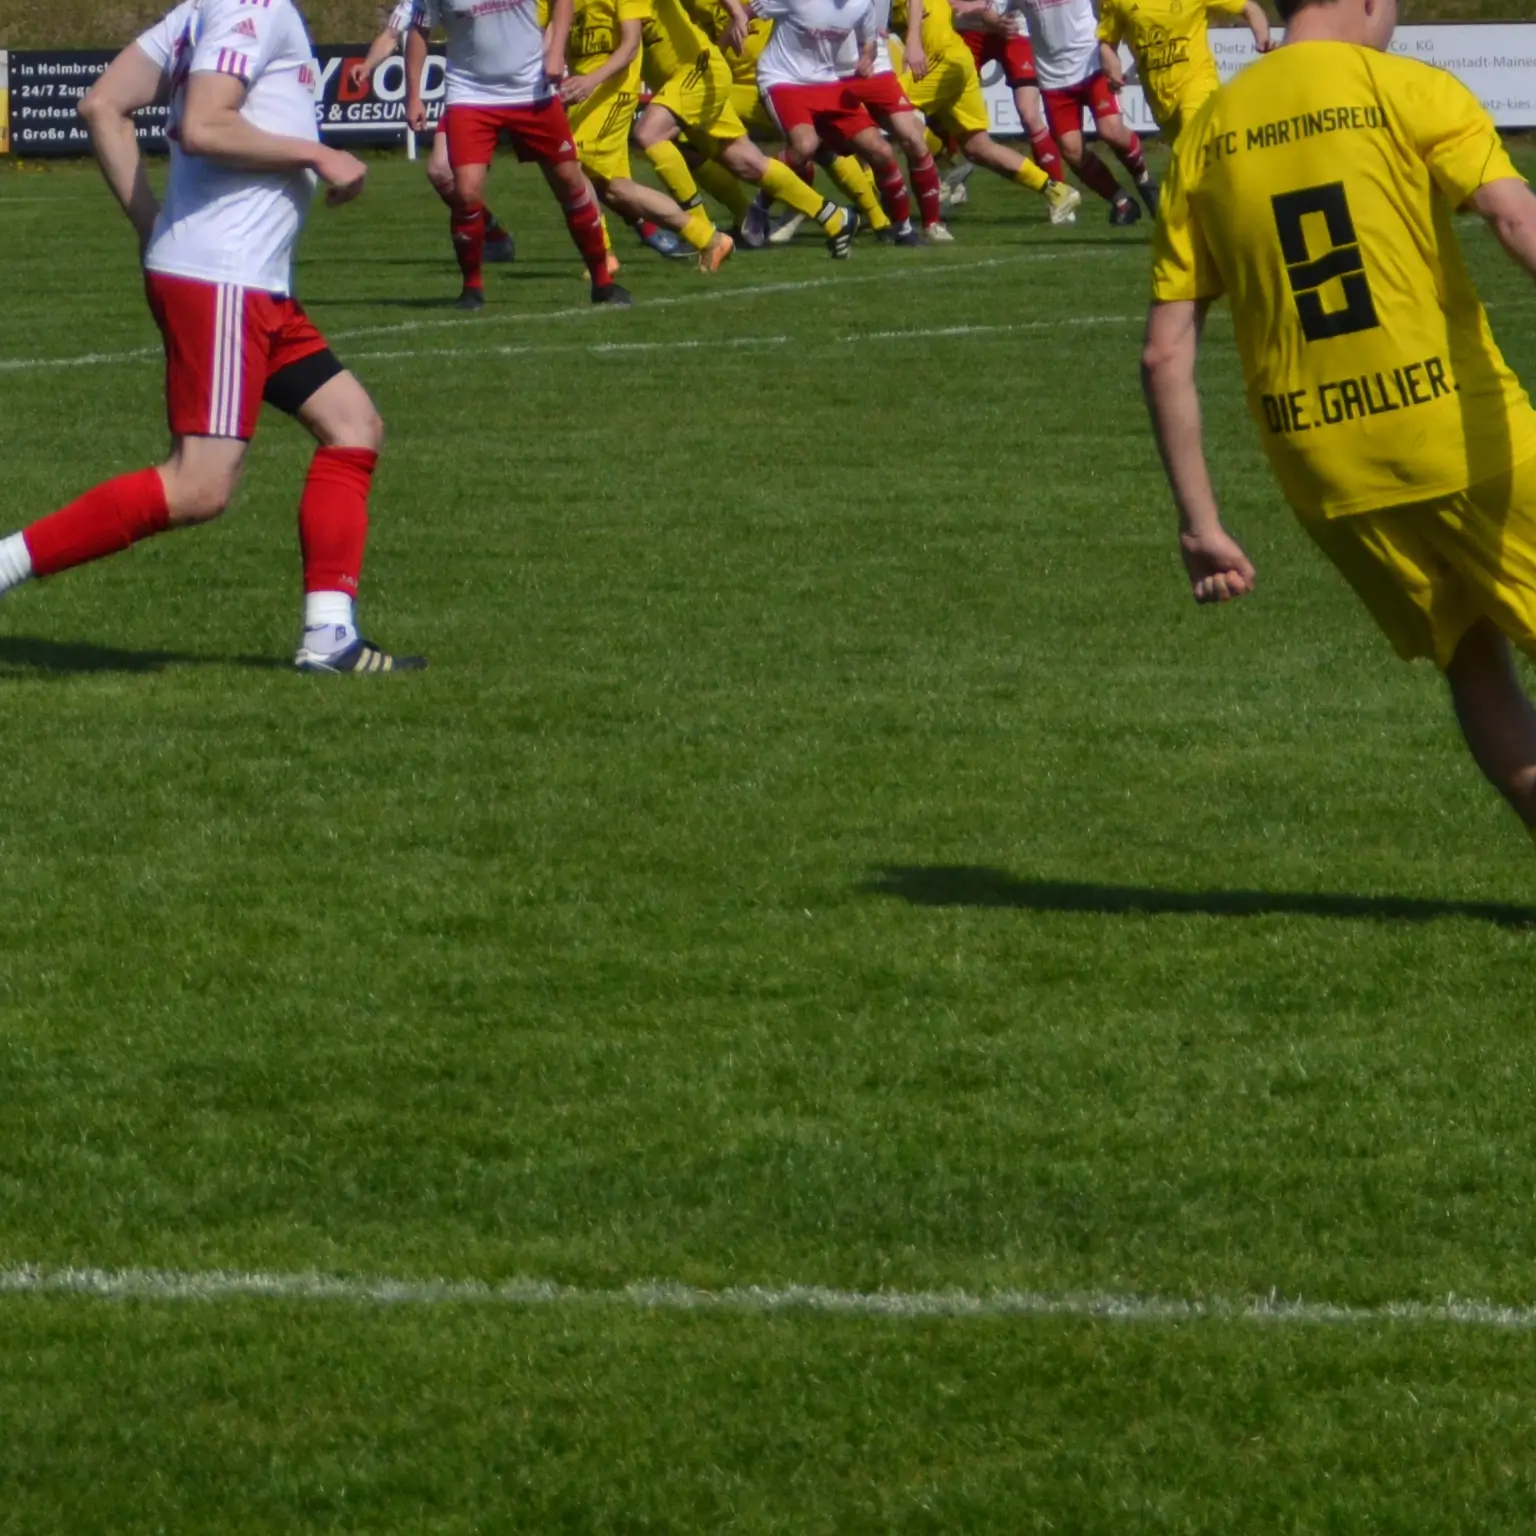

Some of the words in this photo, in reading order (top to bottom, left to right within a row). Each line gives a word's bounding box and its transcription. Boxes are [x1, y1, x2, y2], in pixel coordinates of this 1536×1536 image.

[1214, 42, 1246, 53] Dietz
[1416, 40, 1434, 50] KG
[314, 56, 447, 101] YBOD
[21, 85, 57, 97] 24/7
[23, 107, 77, 118] Profess
[329, 103, 342, 120] &
[23, 128, 65, 140] Große
